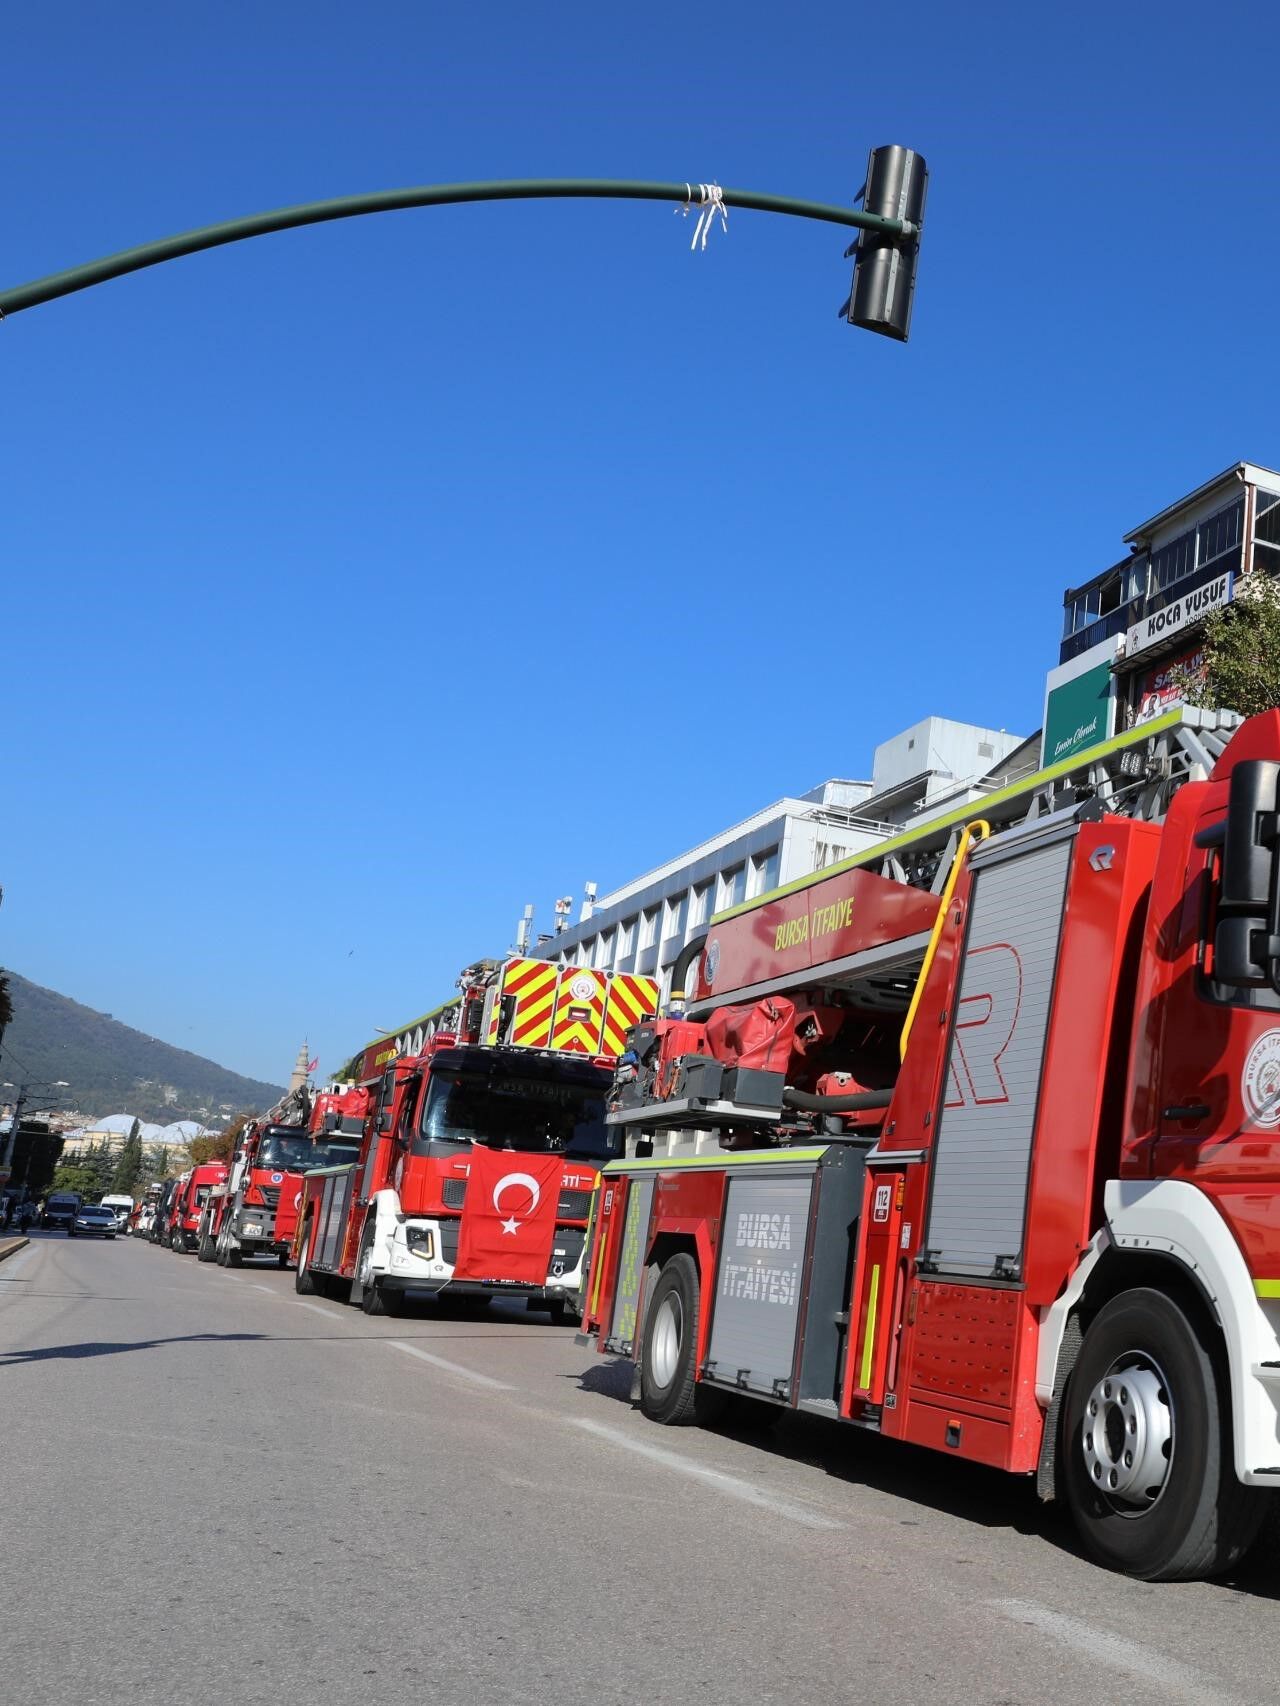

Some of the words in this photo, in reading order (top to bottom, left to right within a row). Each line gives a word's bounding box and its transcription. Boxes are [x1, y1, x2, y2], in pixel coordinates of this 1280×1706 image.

[1148, 604, 1181, 637] KOCA
[1185, 578, 1226, 616] YUSUF
[774, 915, 809, 952] BURSA
[811, 897, 854, 939] İTFAİYE
[878, 1190, 888, 1206] 112
[736, 1213, 791, 1250] BURSA
[723, 1256, 797, 1305] İTFAİYESİ
